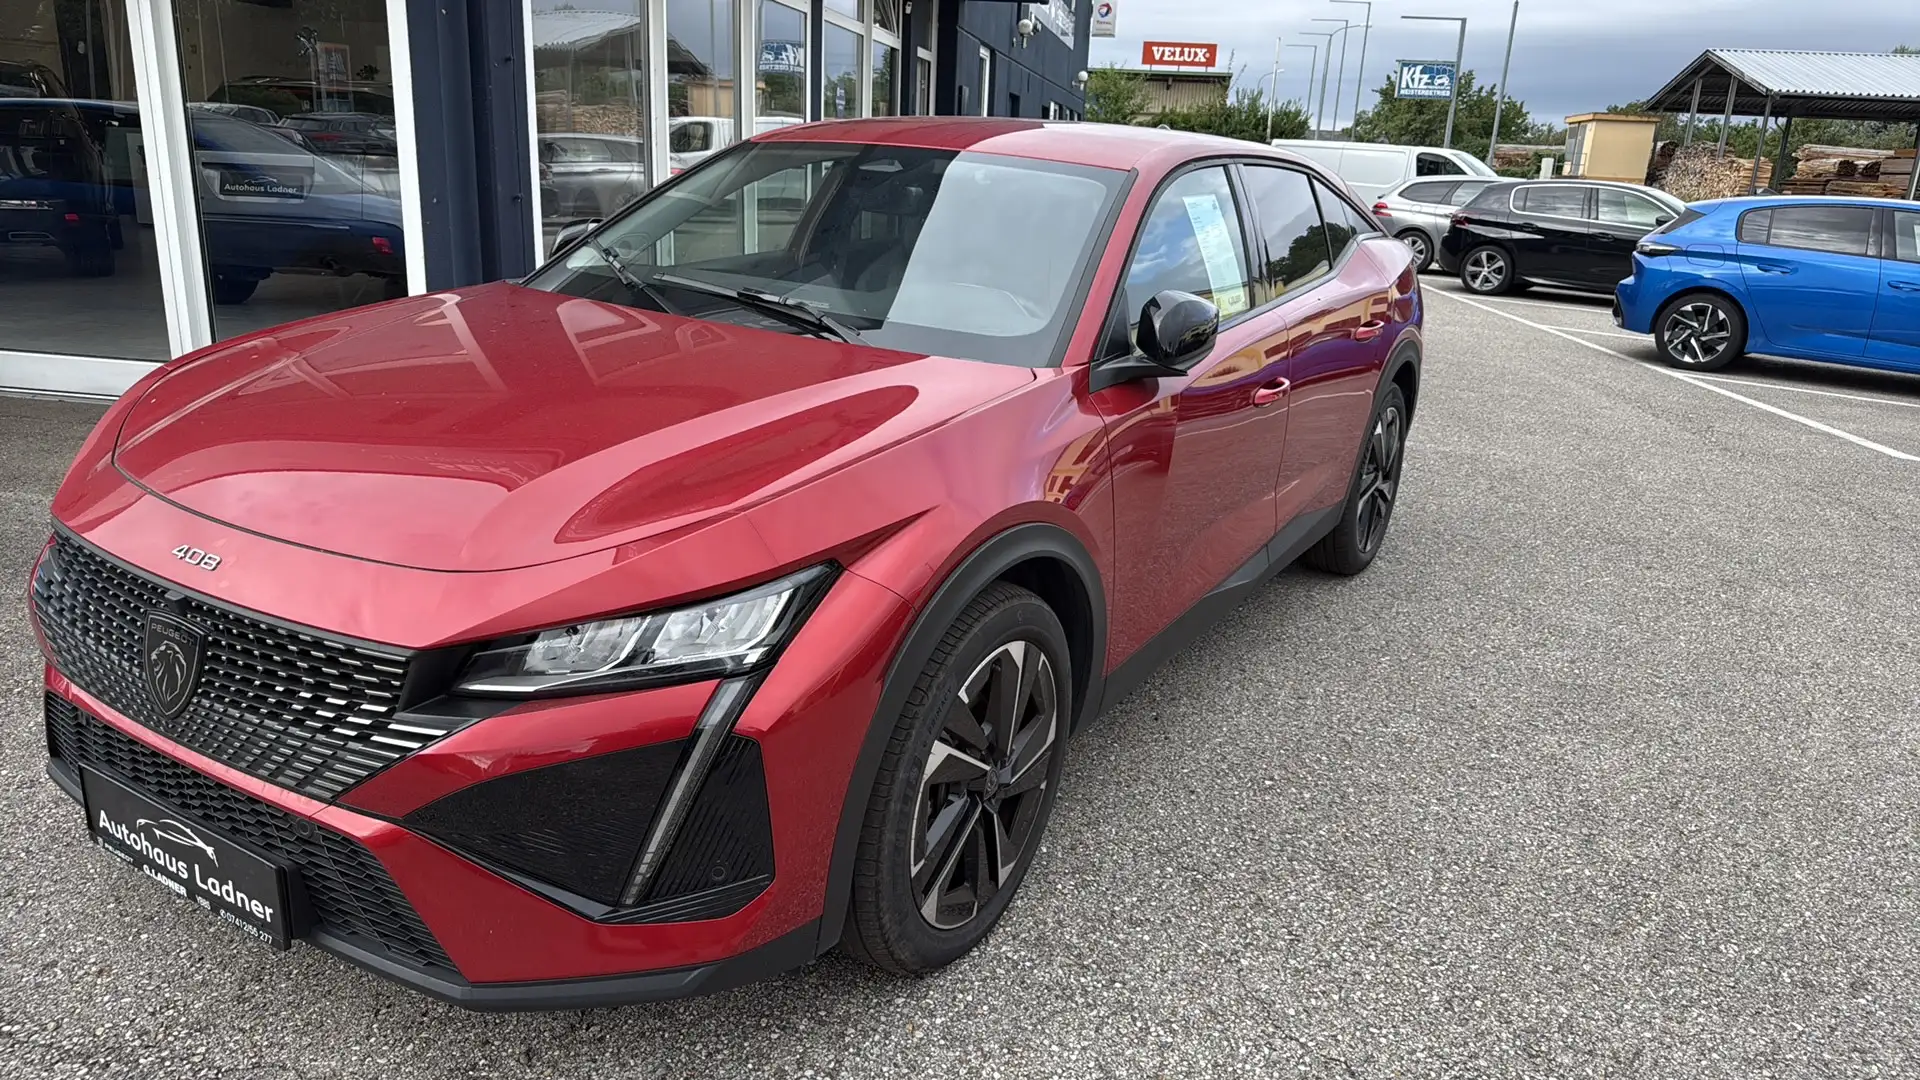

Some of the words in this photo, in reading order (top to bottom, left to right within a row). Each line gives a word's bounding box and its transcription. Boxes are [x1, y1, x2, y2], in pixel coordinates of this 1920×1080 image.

[1152, 46, 1208, 62] VELUX
[1401, 65, 1432, 88] Kfz
[224, 183, 264, 192] Autohaus
[267, 185, 297, 193] Ladner
[171, 544, 221, 571] 408
[151, 623, 194, 646] PEUGEOT
[99, 809, 189, 879] Autohaus
[194, 863, 274, 923] Ladner
[257, 931, 273, 944] 277
